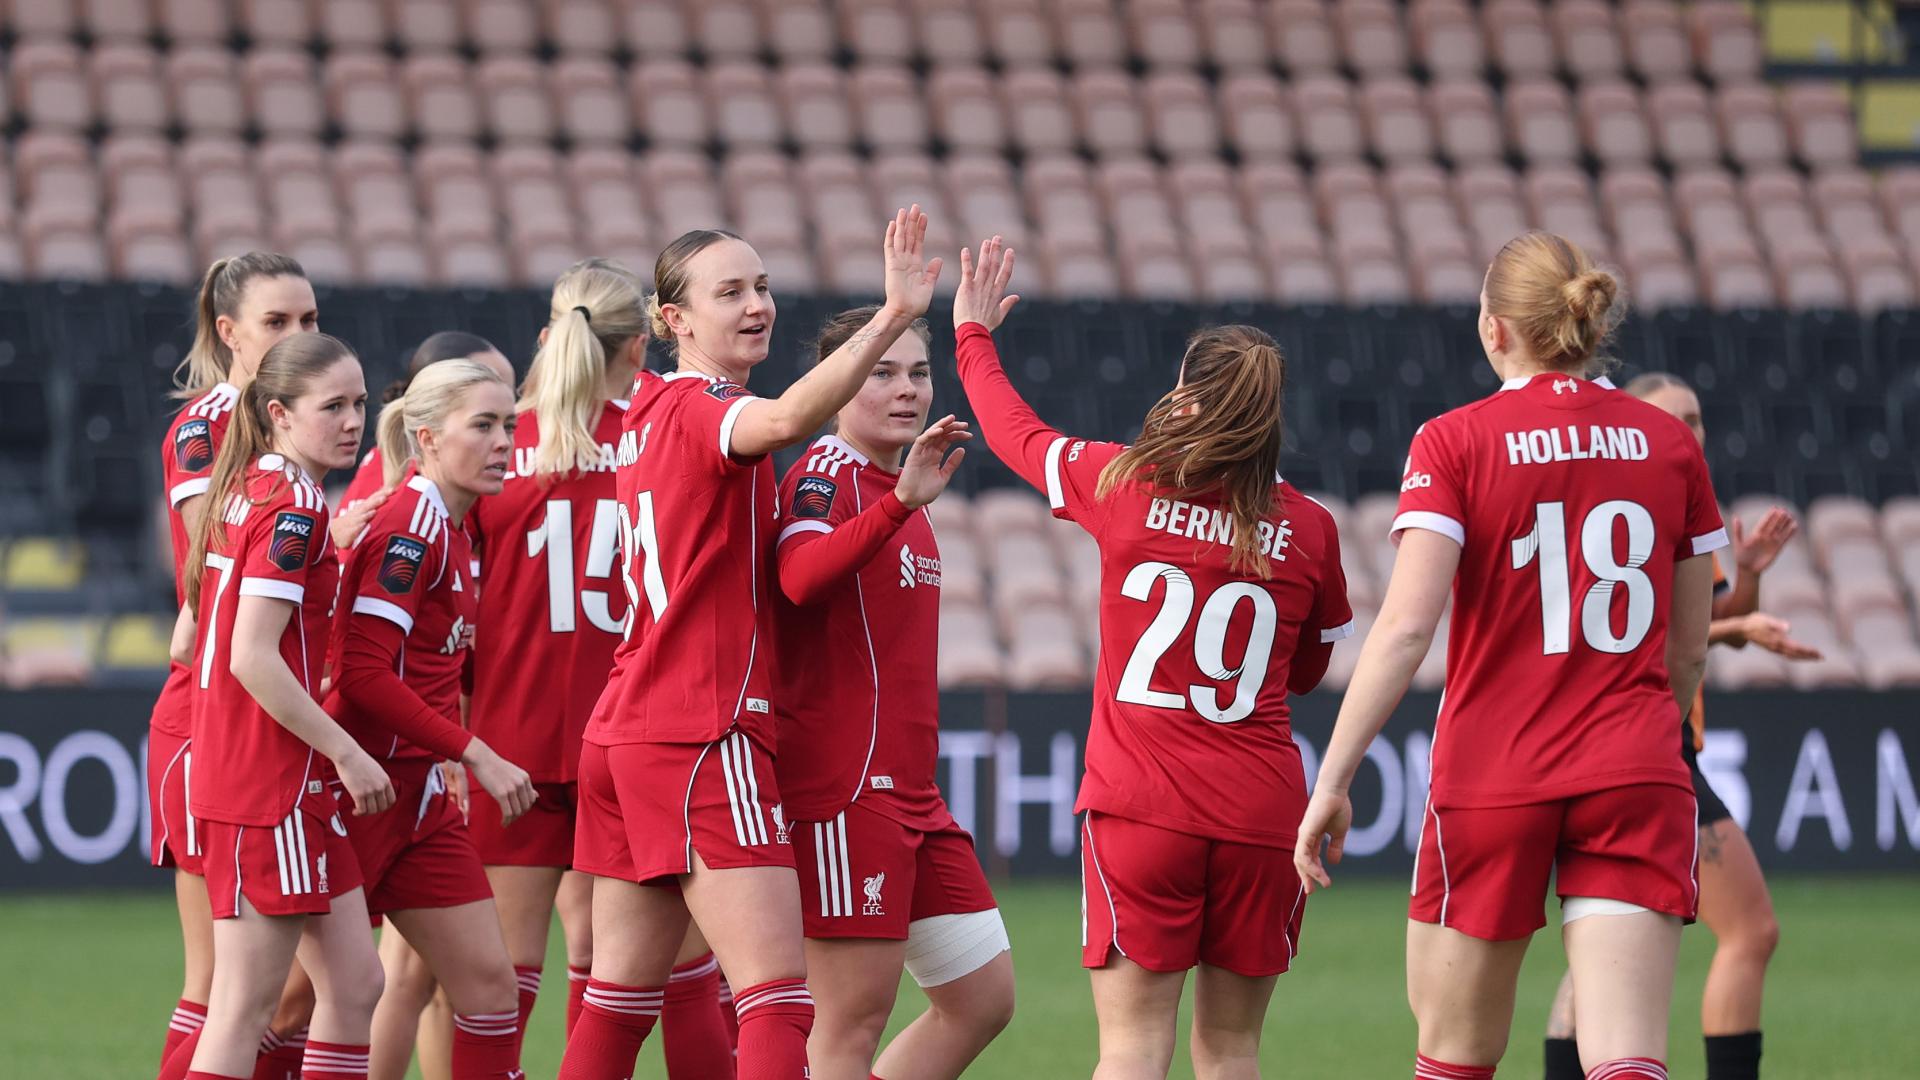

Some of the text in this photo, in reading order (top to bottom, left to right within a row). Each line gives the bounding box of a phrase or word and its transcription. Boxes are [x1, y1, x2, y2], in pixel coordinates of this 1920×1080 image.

[798, 482, 833, 497] WSL
[1505, 425, 1649, 465] HOLLAND
[527, 498, 629, 633] 15
[1145, 498, 1293, 562] BERNBÉ
[1512, 500, 1655, 656] 18
[1116, 561, 1278, 723] 29
[0, 730, 151, 865] RO
